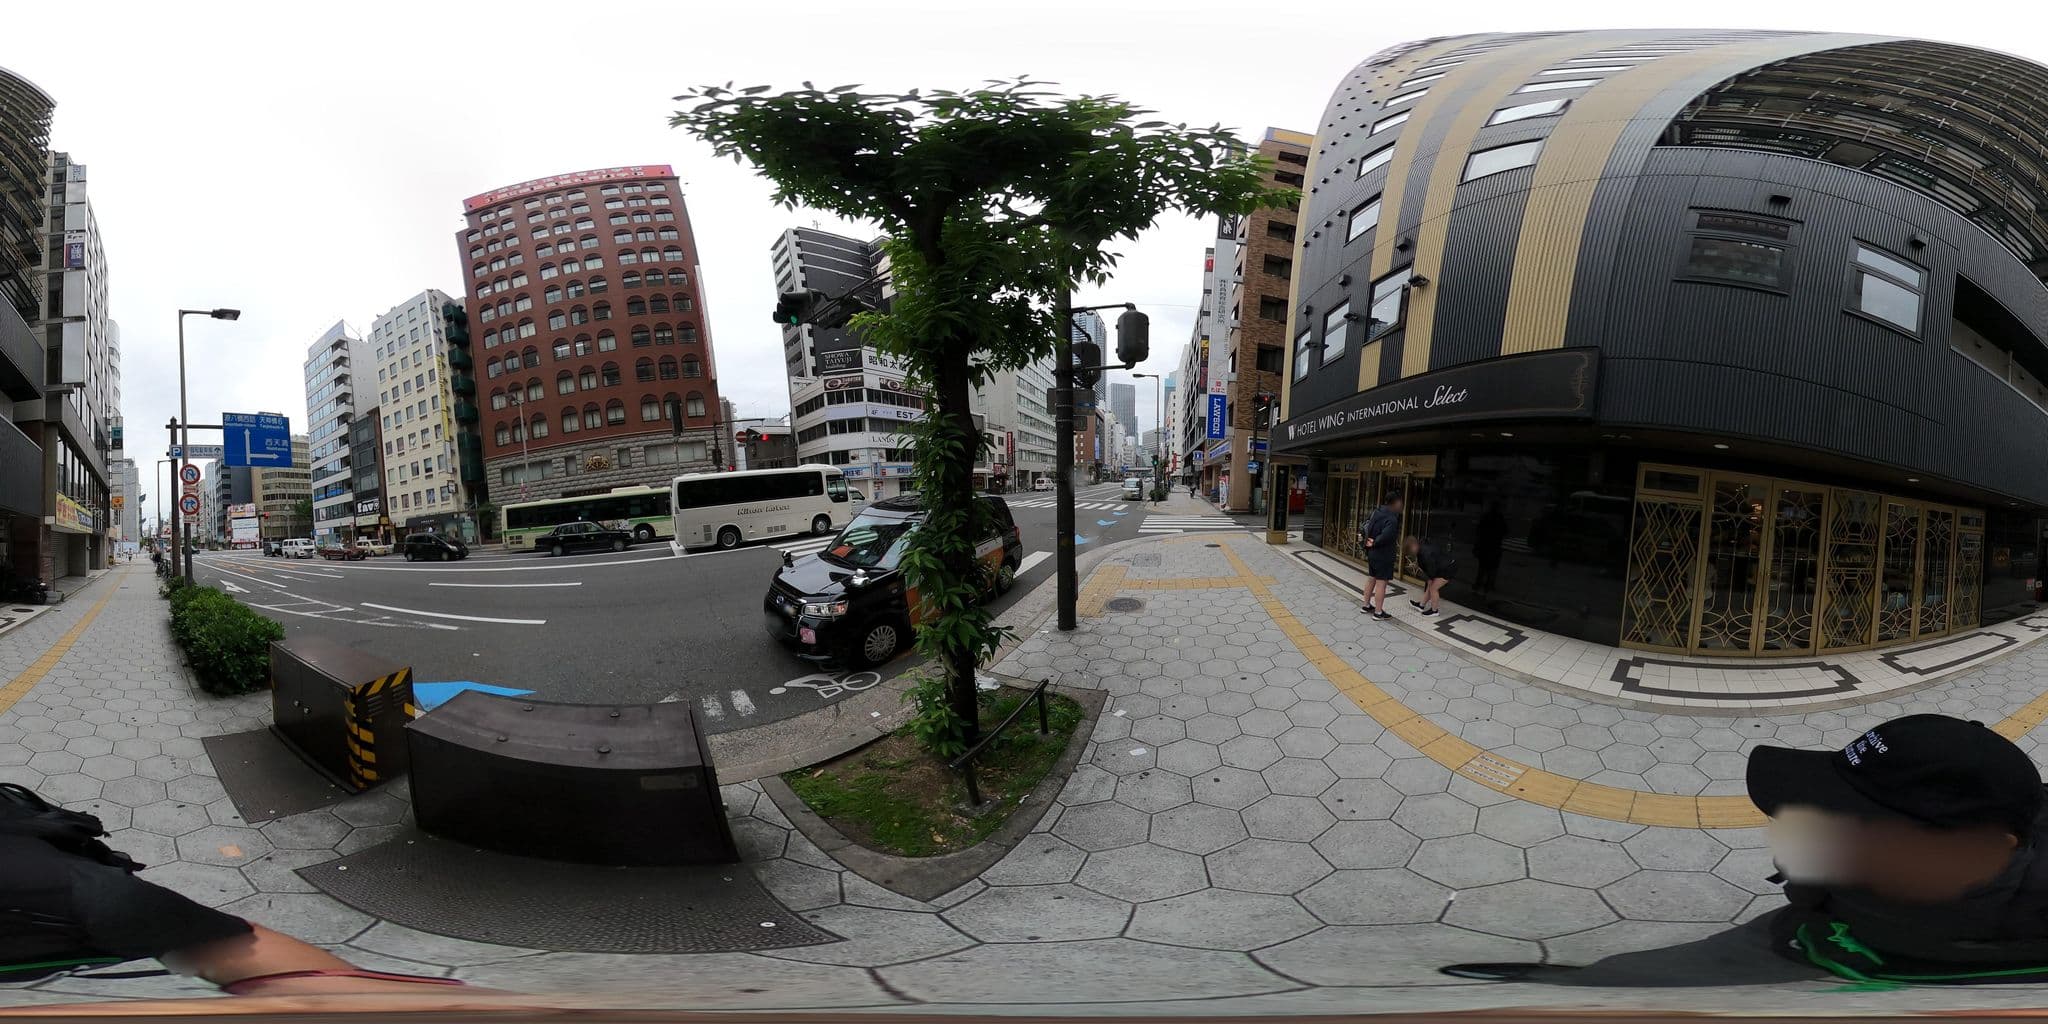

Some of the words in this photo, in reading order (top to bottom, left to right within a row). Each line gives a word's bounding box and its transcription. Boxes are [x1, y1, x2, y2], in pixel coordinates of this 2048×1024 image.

[896, 410, 914, 419] EST
[1213, 398, 1221, 435] LAWSON
[1297, 422, 1317, 438] HOTEL
[1318, 411, 1345, 430] WING
[1347, 396, 1419, 423] INTERNATIONAL
[1424, 385, 1470, 409] Select
